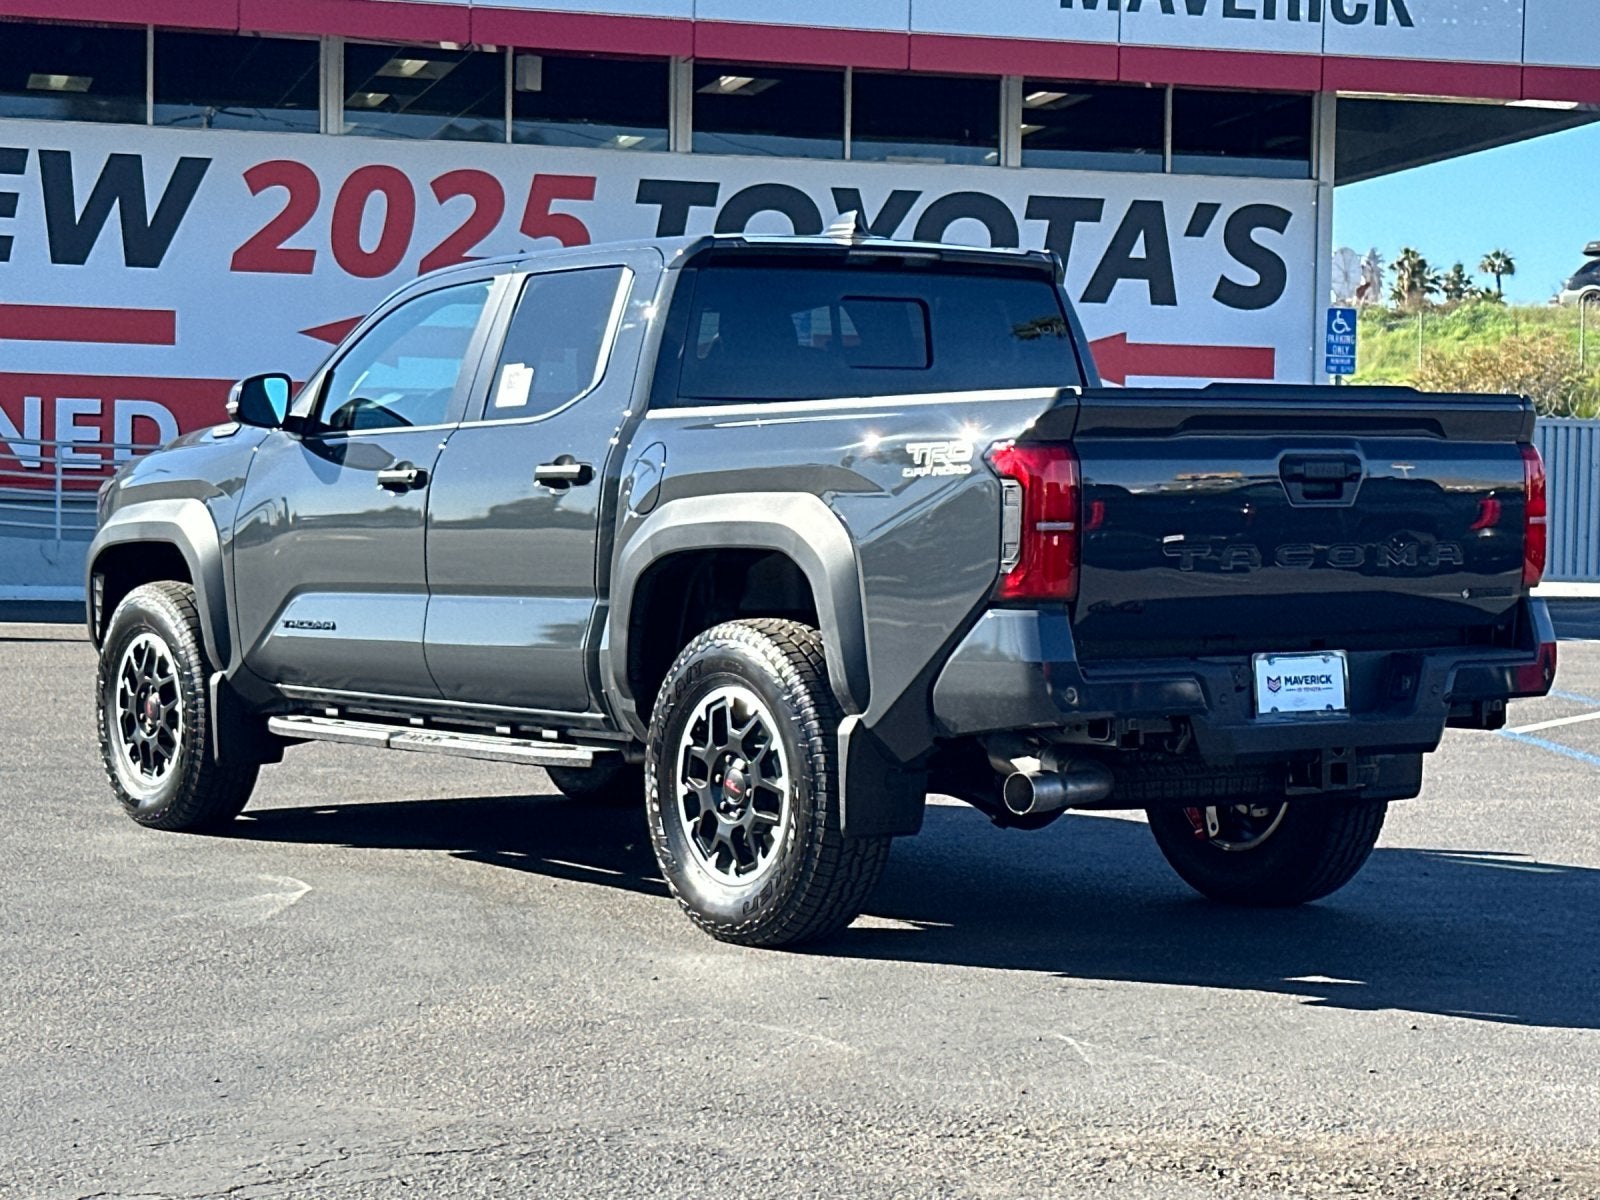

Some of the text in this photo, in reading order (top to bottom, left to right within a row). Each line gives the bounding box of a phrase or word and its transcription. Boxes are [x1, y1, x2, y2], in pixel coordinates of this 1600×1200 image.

[230, 159, 597, 279] 2025
[1328, 334, 1355, 344] PARKING
[1332, 345, 1350, 355] ONLY
[906, 441, 974, 466] TRD
[1162, 542, 1464, 571] TACOMA
[1284, 674, 1333, 686] MAVERICK
